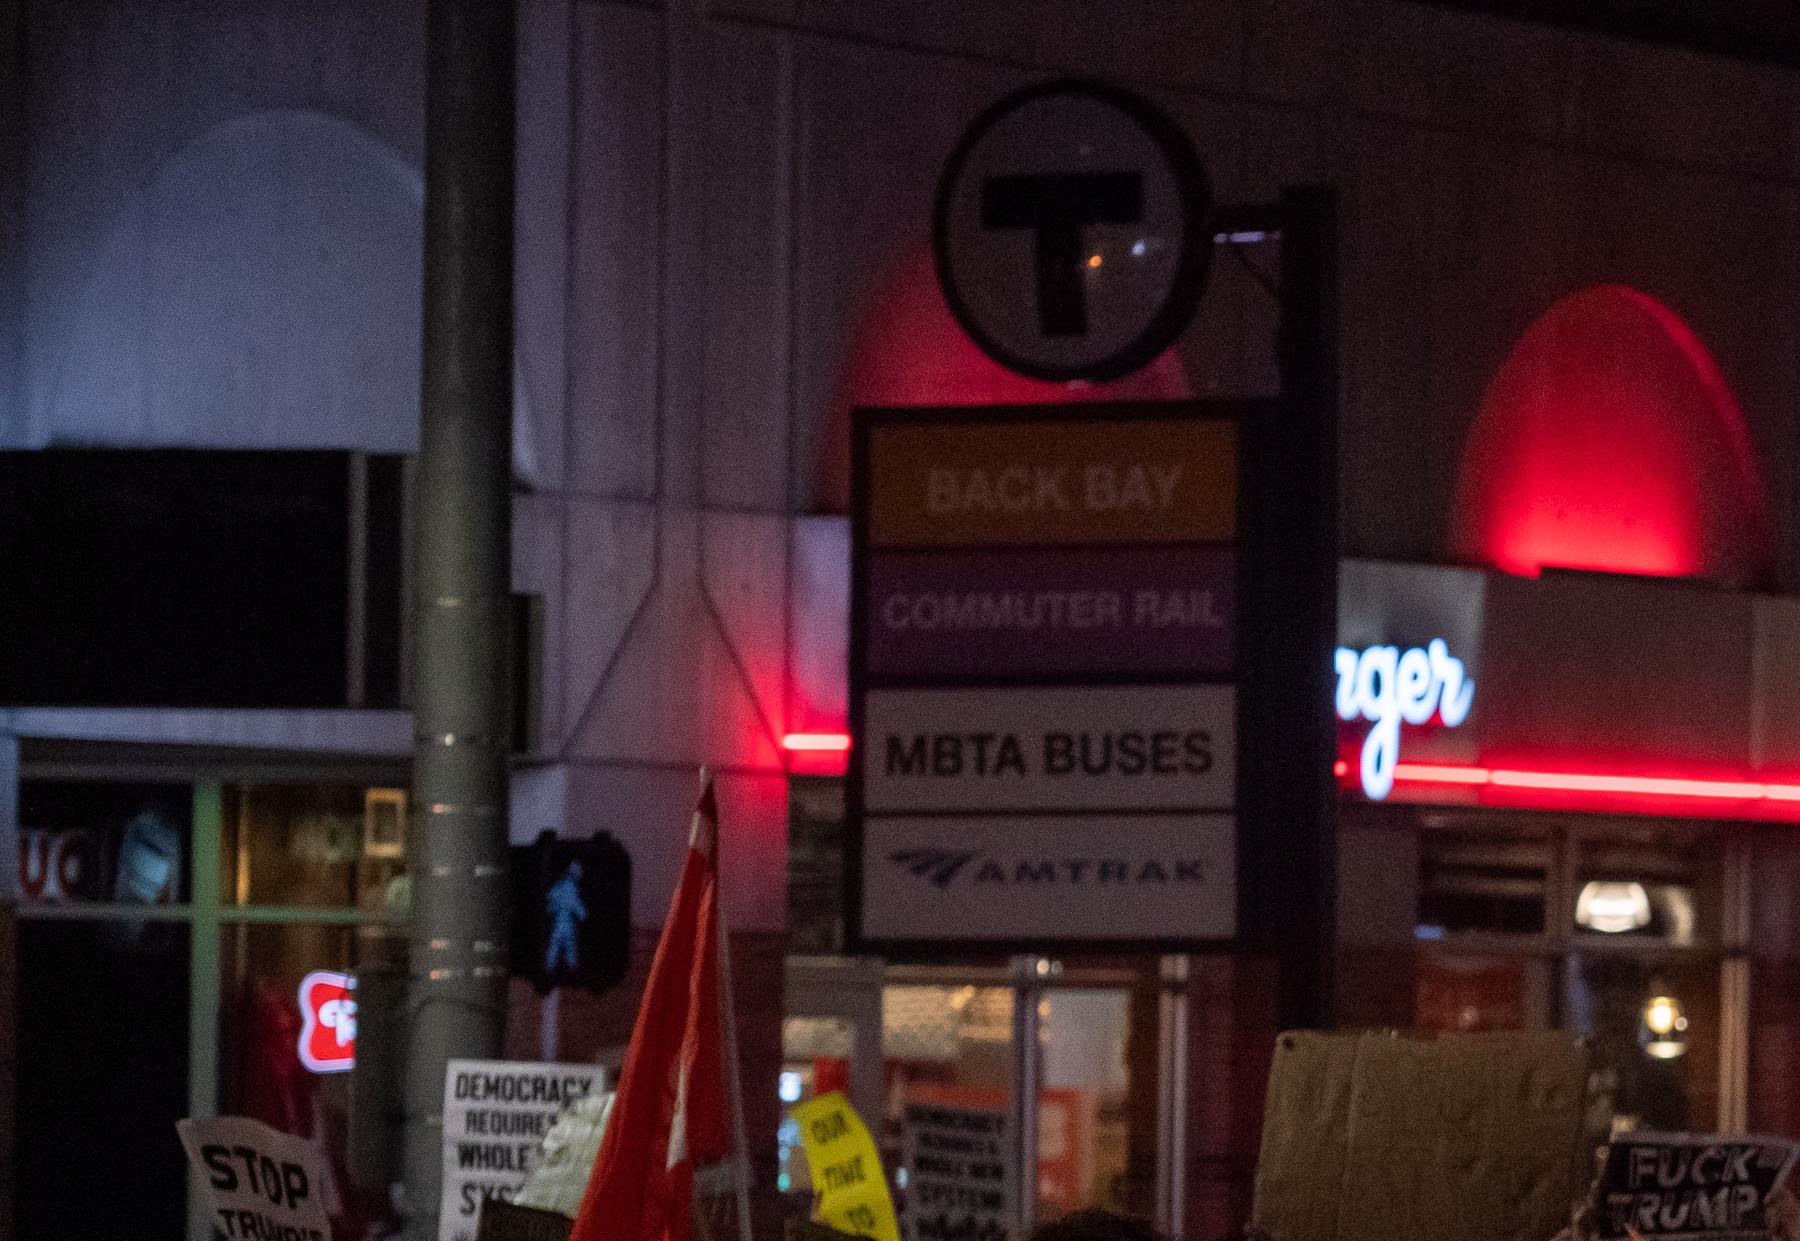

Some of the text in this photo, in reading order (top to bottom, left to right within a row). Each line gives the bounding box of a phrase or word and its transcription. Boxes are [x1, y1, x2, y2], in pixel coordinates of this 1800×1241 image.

[983, 173, 1142, 337] T
[927, 462, 1184, 514] BACK BAY
[883, 588, 1223, 629] COMMUTER RAIL
[886, 729, 1213, 777] MBTA BUSES
[974, 861, 1203, 883] AMTRAK
[201, 1146, 309, 1209] STOP
[1628, 1146, 1759, 1187] FUCK
[1607, 1183, 1759, 1234] TRUMP
